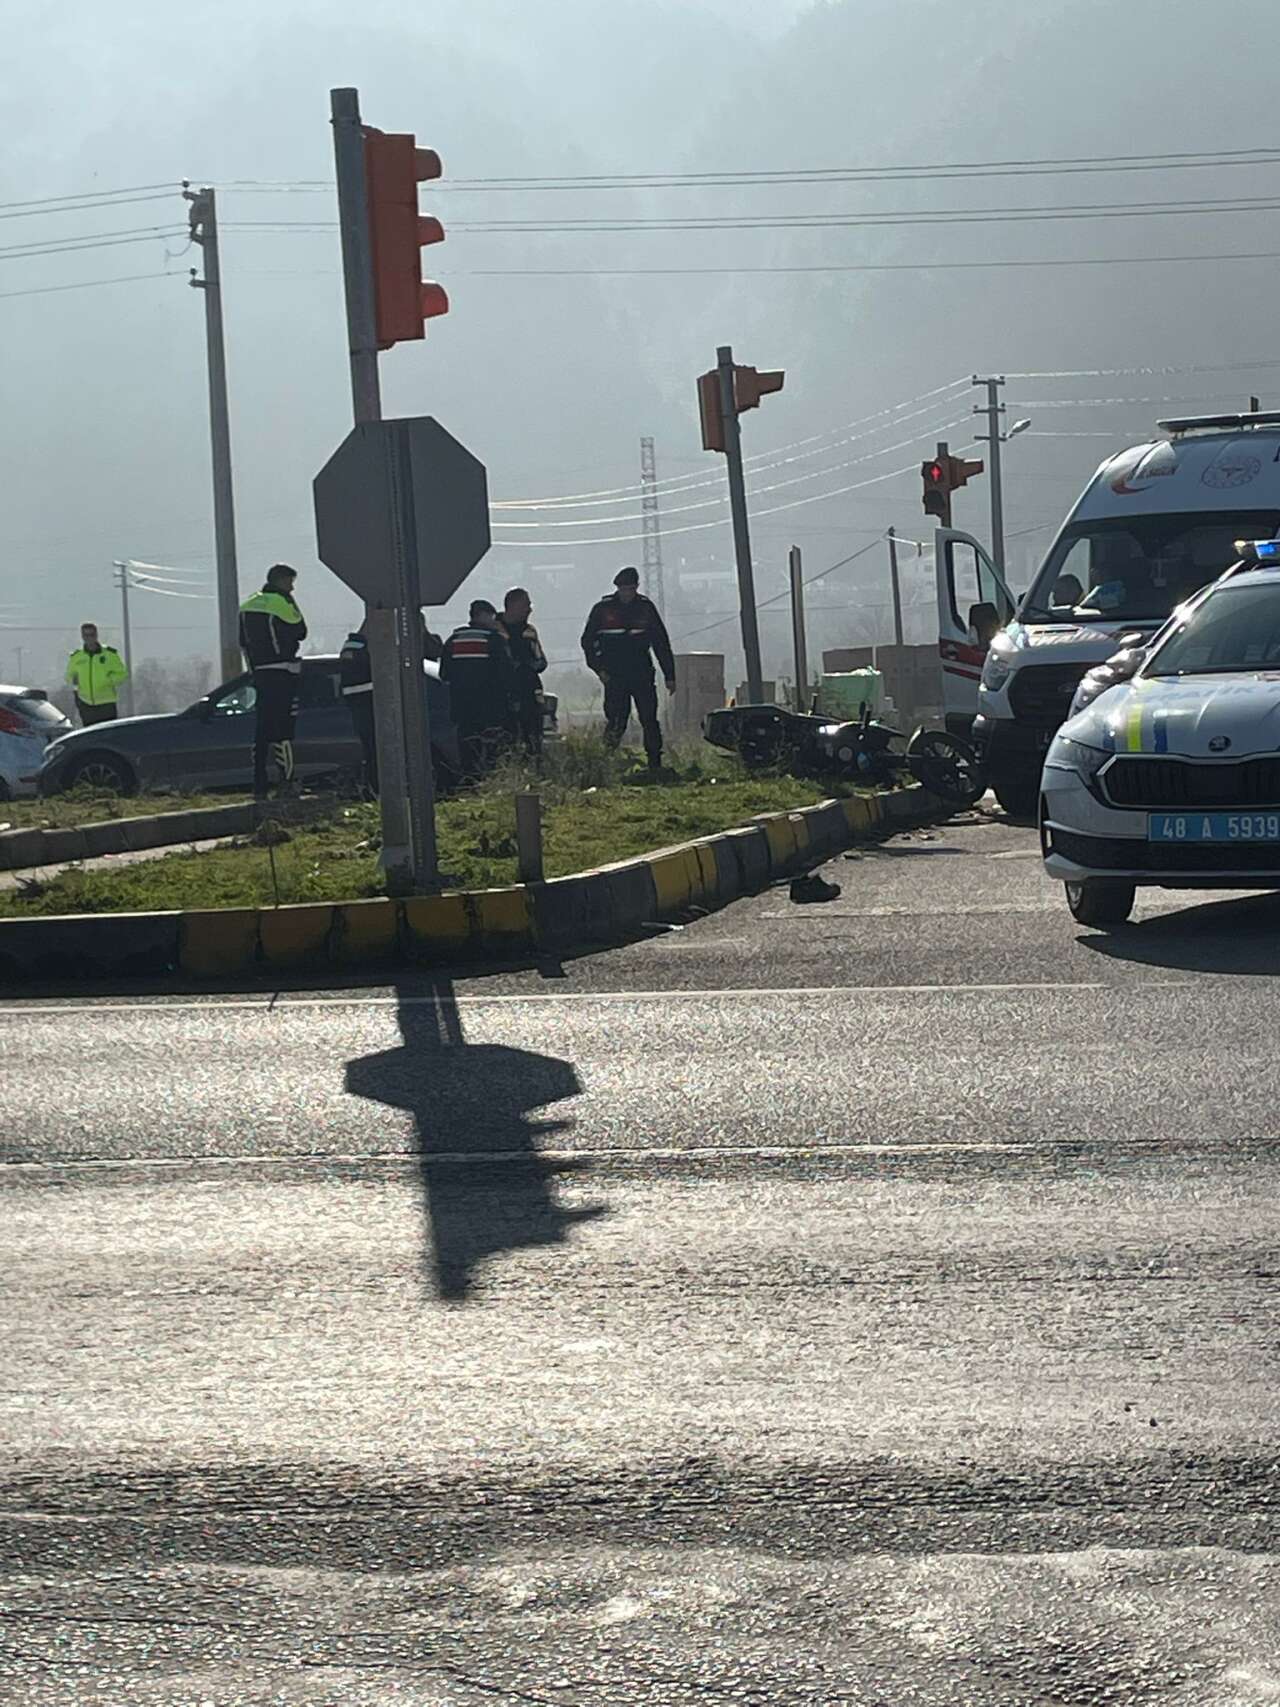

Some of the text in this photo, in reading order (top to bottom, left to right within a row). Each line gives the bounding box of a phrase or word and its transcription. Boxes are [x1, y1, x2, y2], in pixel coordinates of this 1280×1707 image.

[1162, 815, 1279, 839] 48 A 5939
